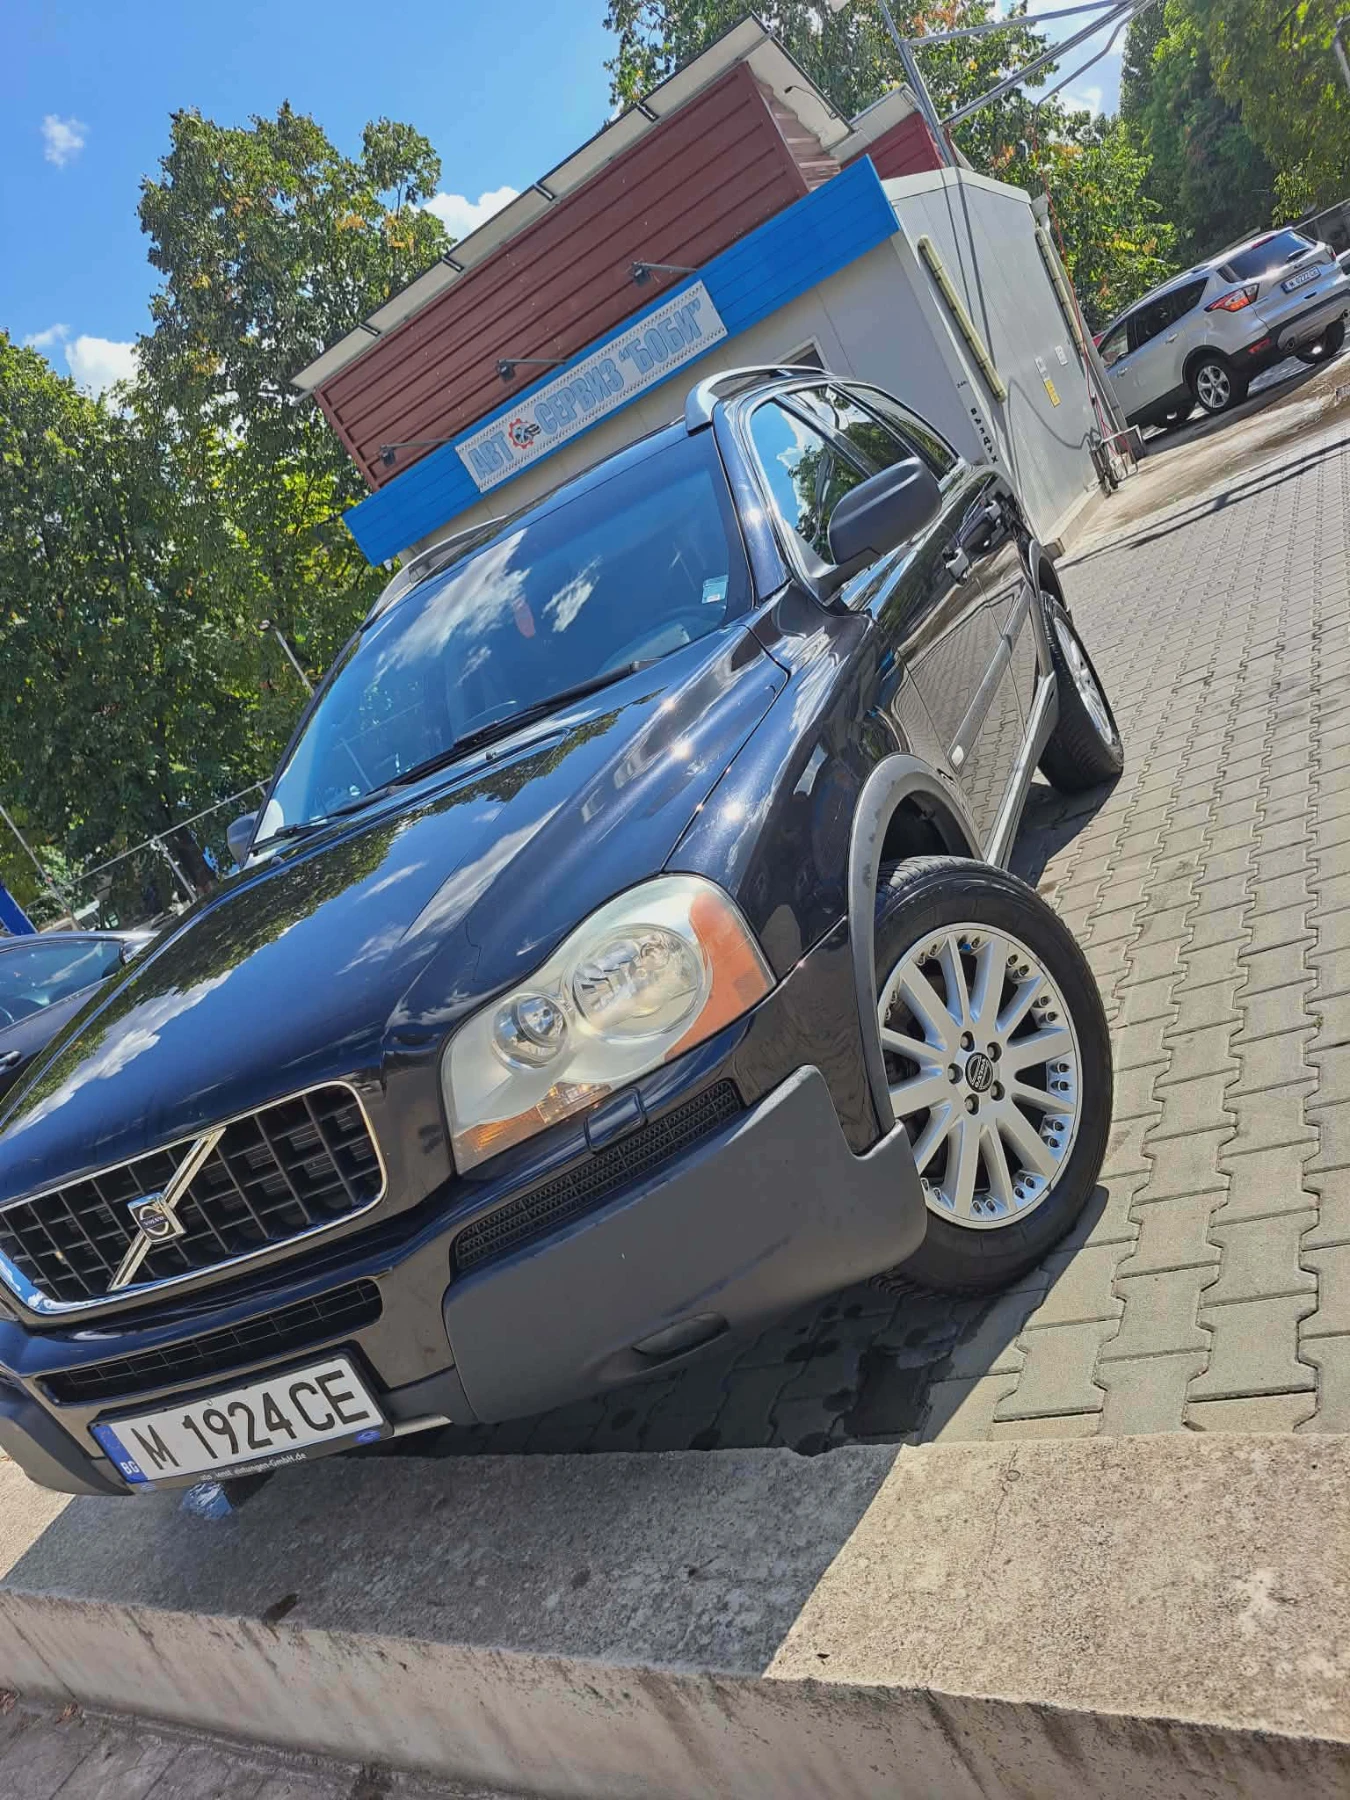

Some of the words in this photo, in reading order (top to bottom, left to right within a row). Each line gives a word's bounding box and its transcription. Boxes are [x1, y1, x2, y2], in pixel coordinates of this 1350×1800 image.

[534, 358, 625, 434] СЕРВИЗ
[975, 1058, 987, 1088] VOLVO
[144, 1215, 164, 1226] VOLVO
[131, 1424, 180, 1469] M
[182, 1392, 297, 1459] 1924
[120, 1460, 140, 1474] BG
